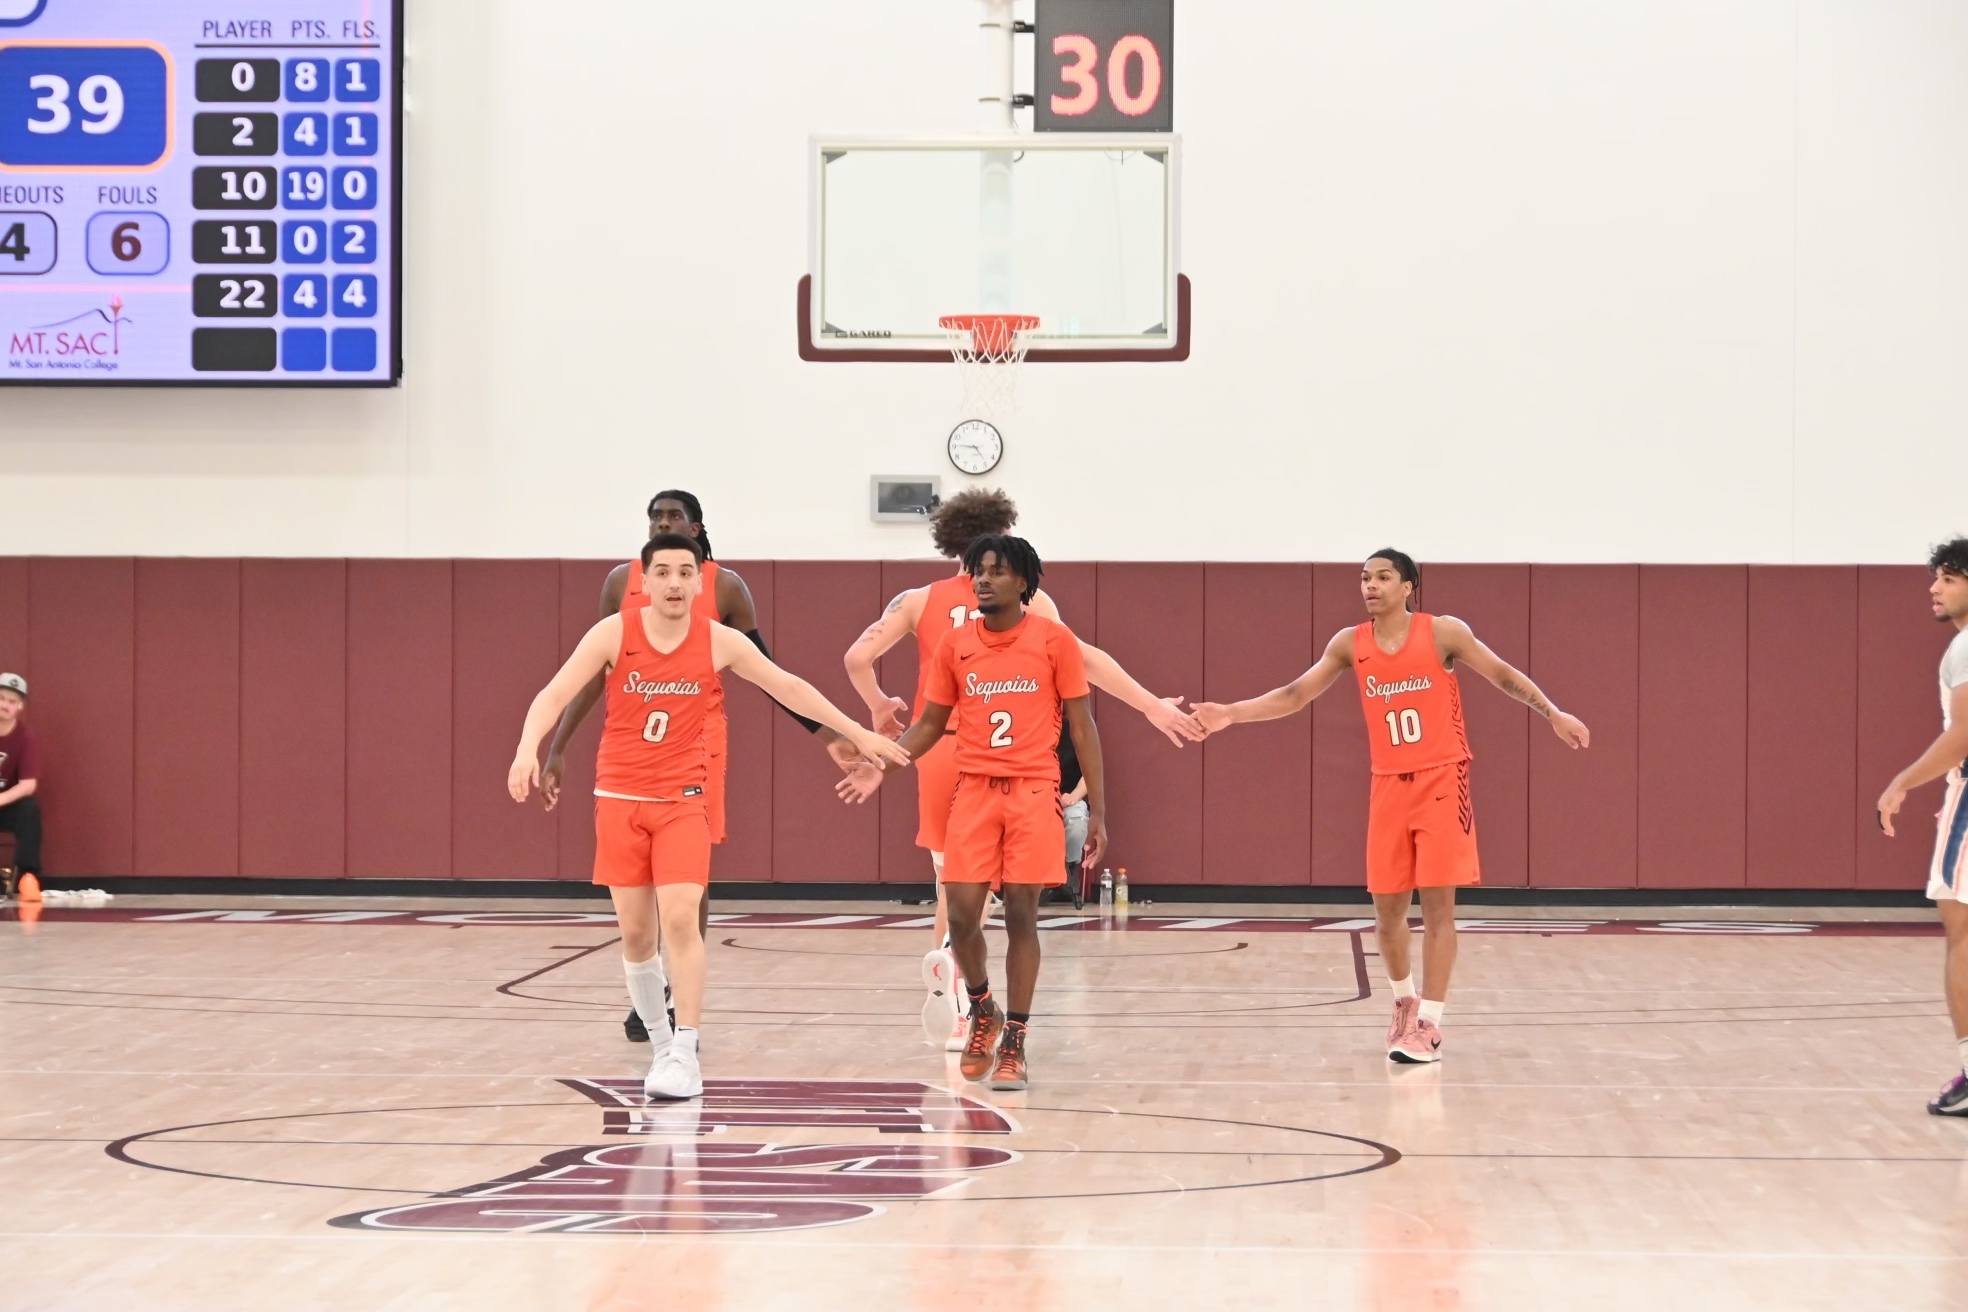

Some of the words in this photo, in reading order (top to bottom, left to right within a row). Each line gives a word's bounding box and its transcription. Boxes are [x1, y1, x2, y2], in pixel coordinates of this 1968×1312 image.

[202, 20, 273, 38] PLAYER
[291, 20, 331, 38] PTS.
[343, 20, 380, 38] FLS.
[231, 62, 255, 92] 0
[294, 62, 318, 92] 8
[345, 63, 367, 91] 1
[1050, 34, 1162, 116] 30
[27, 74, 125, 134] 39
[231, 117, 254, 146] 2
[293, 117, 318, 146] 4
[345, 117, 367, 146] 1
[98, 186, 158, 204] FOULS
[220, 171, 267, 201] 10
[288, 171, 325, 201] 19
[343, 171, 367, 200] 0
[0, 222, 31, 262] 4
[111, 221, 142, 262] 6
[220, 226, 266, 255] 11
[293, 226, 318, 255] 0
[343, 225, 366, 254] 2
[219, 280, 266, 309] 22
[292, 280, 318, 308] 4
[342, 279, 367, 307] 4
[10, 332, 50, 355] MT.
[56, 332, 108, 355] SAC
[25, 360, 42, 369] San
[45, 360, 81, 369] Antonio
[83, 360, 118, 372] College
[623, 671, 702, 703] Sequoias
[965, 672, 1040, 704] Sequoias
[1365, 674, 1432, 704] Sequoias
[642, 709, 670, 744] 0
[989, 710, 1014, 748] 2
[1384, 707, 1422, 746] 10
